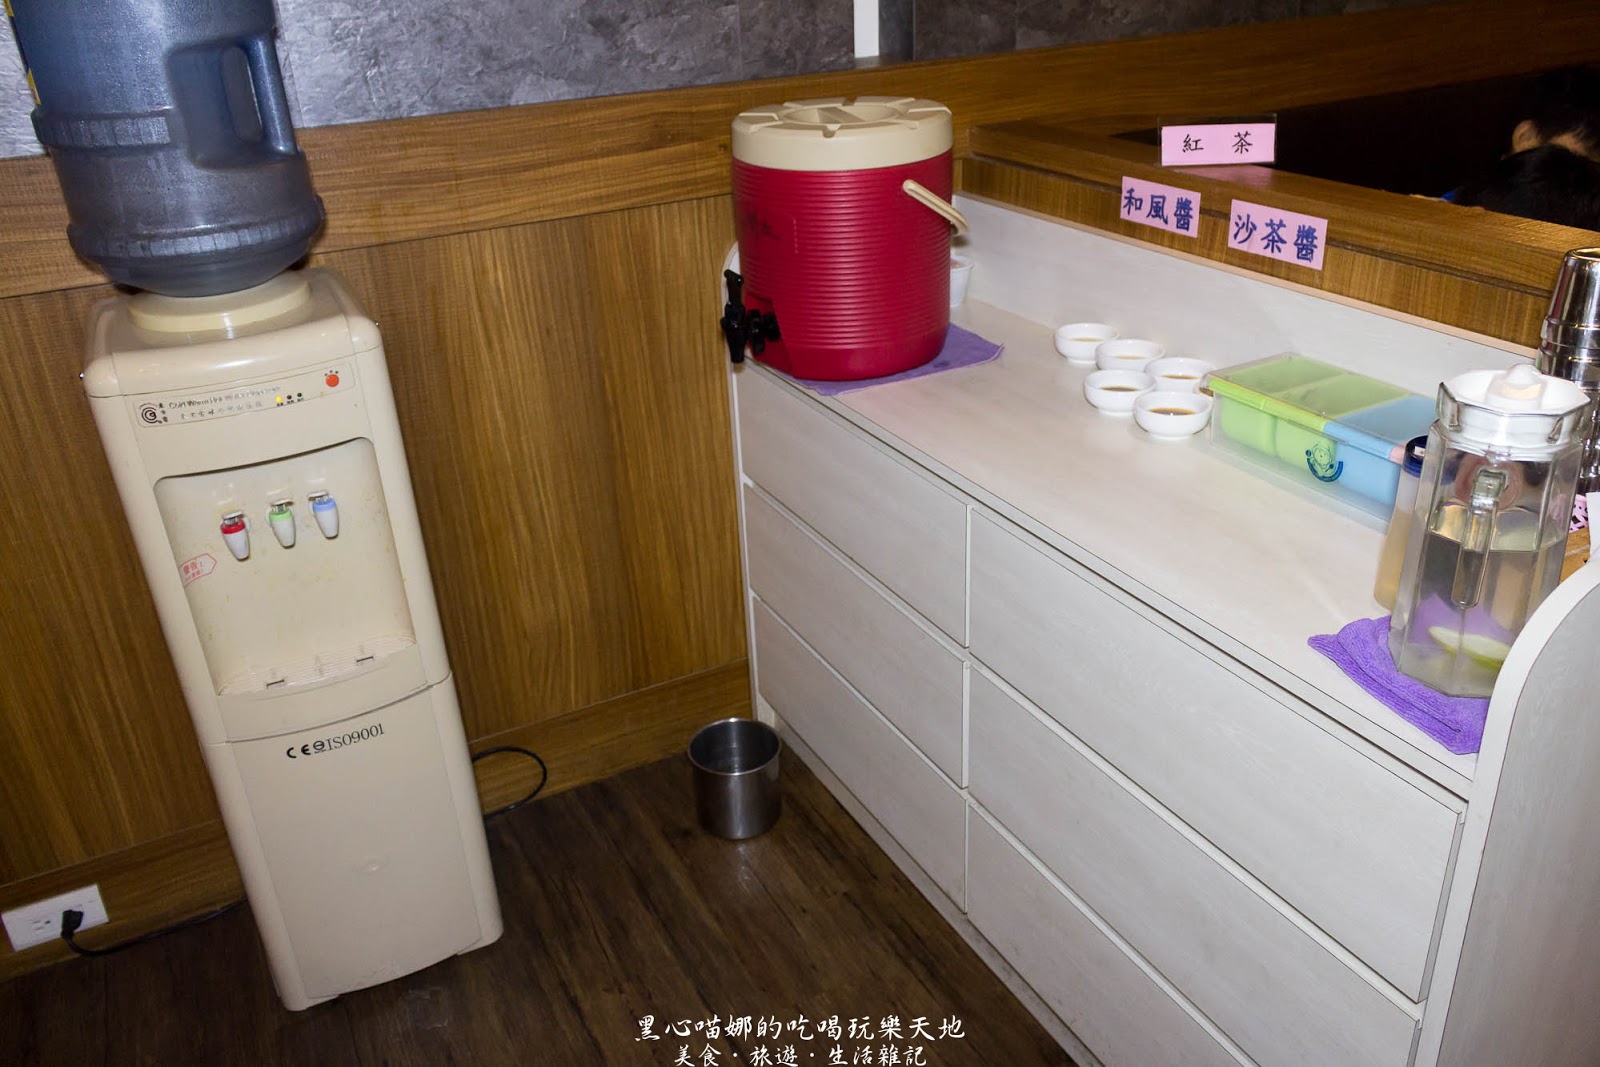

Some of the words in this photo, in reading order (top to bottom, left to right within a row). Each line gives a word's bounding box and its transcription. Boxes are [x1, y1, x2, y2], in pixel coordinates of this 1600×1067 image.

[1182, 130, 1253, 154] 紅茶
[1122, 187, 1194, 232] 和風醬
[1233, 213, 1319, 263] 沙茶醬
[325, 723, 385, 751] ISO9001
